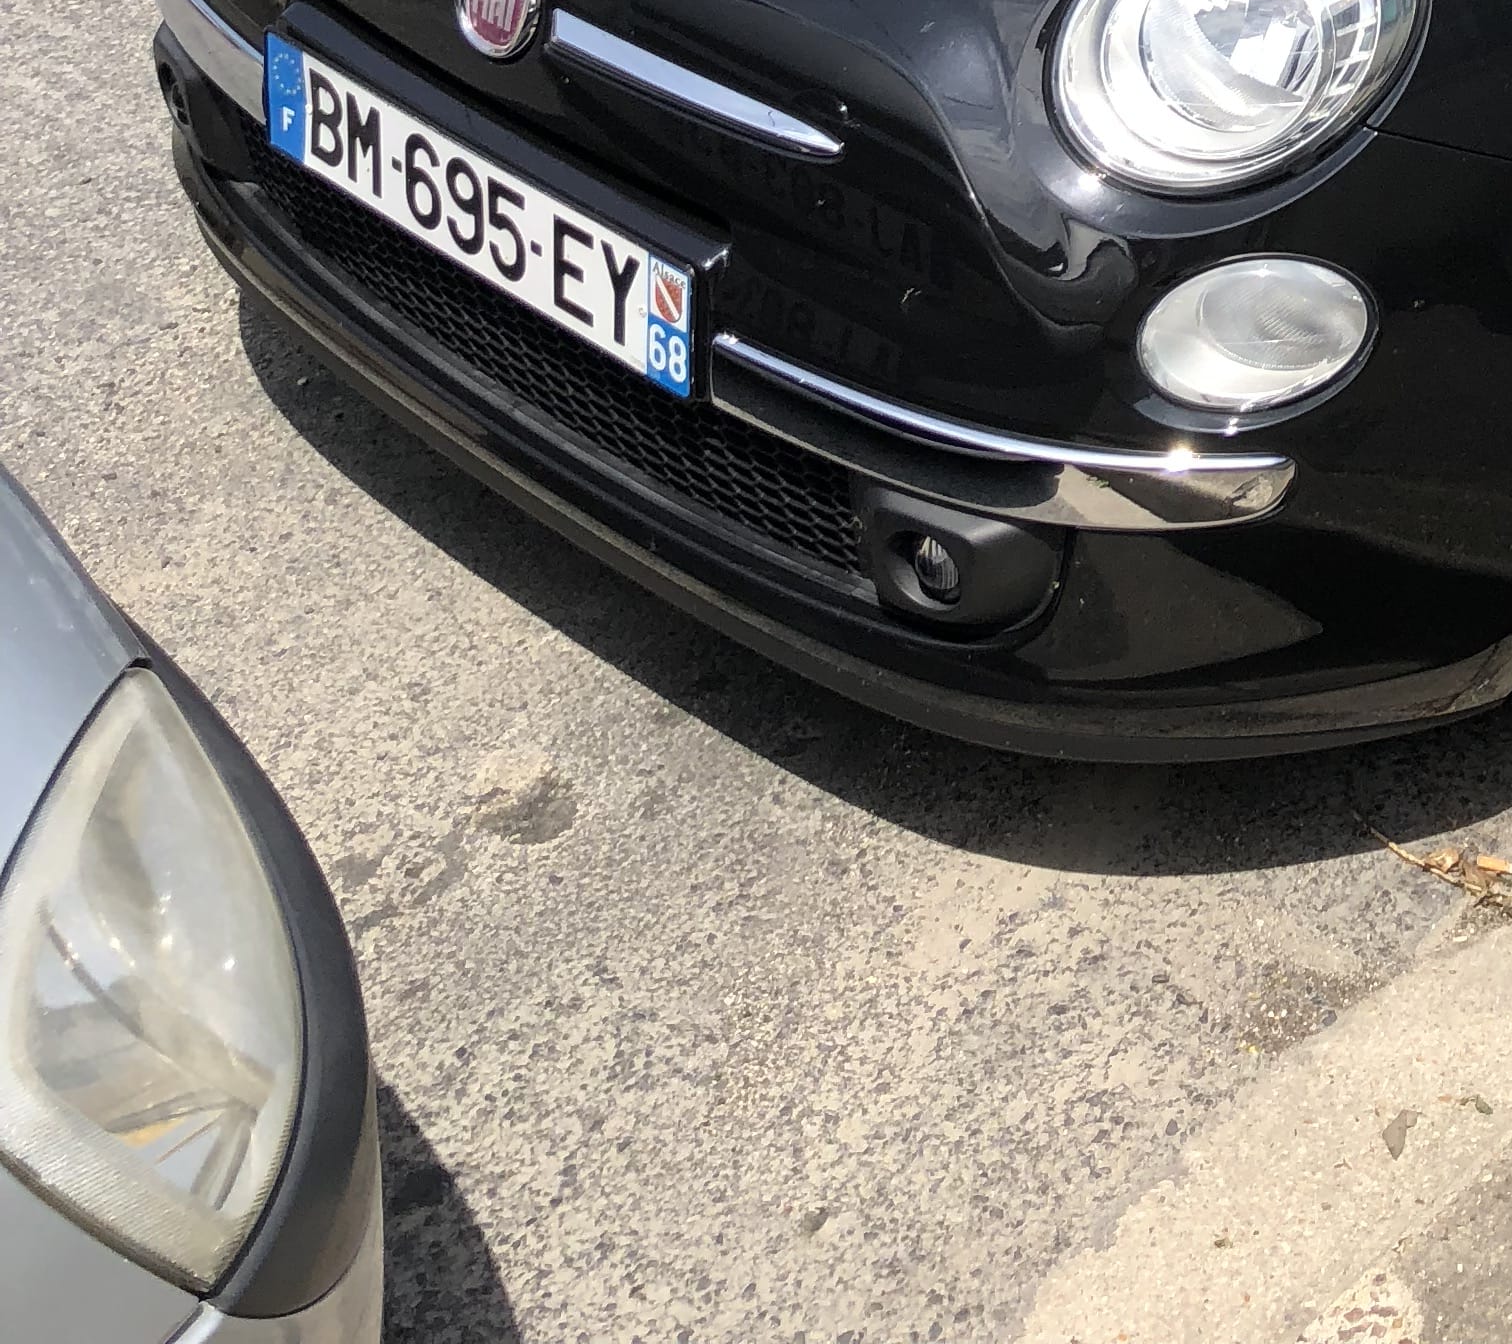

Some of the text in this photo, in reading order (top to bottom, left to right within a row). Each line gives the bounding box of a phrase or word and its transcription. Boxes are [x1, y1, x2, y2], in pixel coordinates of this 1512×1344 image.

[283, 67, 641, 347] F BM-695-EY
[652, 261, 686, 289] Alsace
[649, 323, 687, 383] 68
